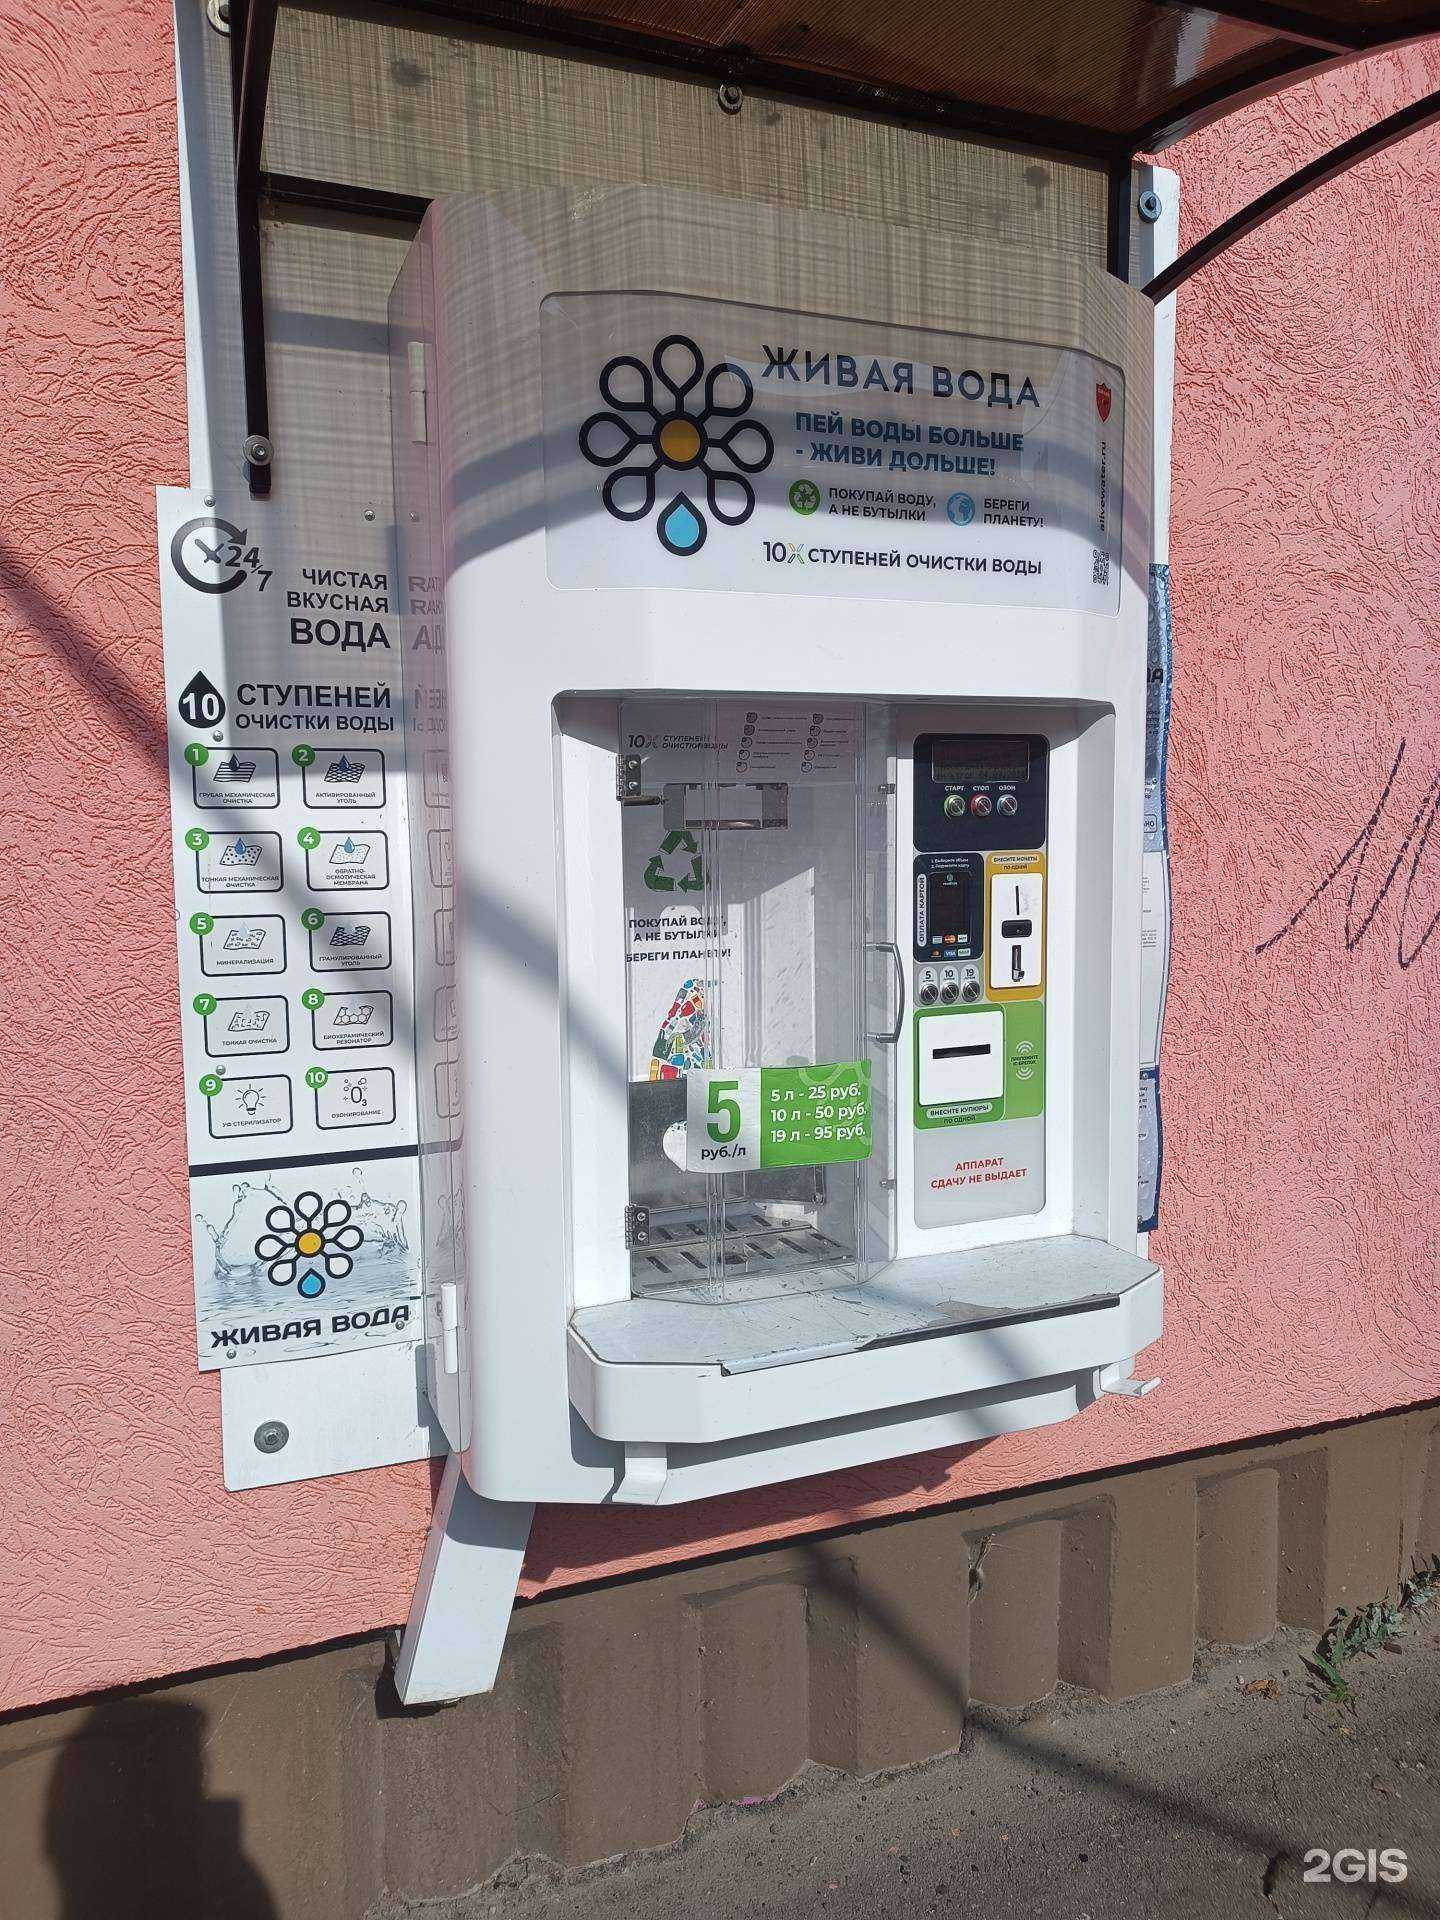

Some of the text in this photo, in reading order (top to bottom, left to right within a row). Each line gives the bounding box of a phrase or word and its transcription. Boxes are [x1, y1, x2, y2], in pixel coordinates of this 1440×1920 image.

[761, 344, 1041, 409] ЖИВАЯ ВОДА
[795, 411, 1024, 451] ПЕЙ ВОДЫ БОЛЬШЕ
[810, 442, 882, 466] ЖИВИ
[889, 450, 996, 476] ДОЛЬШЕ!
[1097, 441, 1107, 532] alivewater.ru
[829, 487, 936, 508] ПОКУПАЙ ВОДУ,
[984, 498, 1030, 511] БЕРЕГИ
[829, 504, 926, 521] А НЕ БУТЫЛКИ
[983, 513, 1044, 528] ПЛАНЕТУ!
[808, 548, 901, 568] СТУПЕНЕЙ
[906, 554, 987, 572] ОЧИСТКИ
[992, 558, 1042, 576] ВОДЫ
[302, 568, 387, 590] ЧИСТАЯ
[287, 591, 389, 613] ВКУСНАЯ
[290, 618, 391, 652] ВОДА
[236, 682, 391, 708] СТУПЕНЕЙ
[182, 693, 220, 720] 10
[235, 714, 330, 730] ОЧИСТКИ
[336, 715, 394, 733] ВОДЫ
[192, 748, 199, 761] 1
[298, 749, 309, 761] 2
[192, 833, 203, 846] 3
[303, 832, 315, 845] 4
[196, 918, 208, 930] 5
[308, 913, 318, 925] 6
[628, 916, 687, 929] ПОКУПАЙ
[633, 932, 642, 942] А
[645, 931, 661, 941] НЕ
[216, 958, 274, 966] МИНЕРАЛИЗАЦИЯ
[319, 954, 382, 962] ГРАНУЛИРОВАННЫЙ
[626, 952, 670, 963] БЕРЕГИ
[925, 971, 931, 979] 5
[945, 970, 953, 978] 10
[966, 968, 974, 976] 19
[199, 999, 210, 1011] 7
[308, 993, 319, 1005] 8
[323, 1031, 385, 1040] БИОКЕРАМИЧЕСКИЙ
[336, 1037, 372, 1045] РЕЗОНАТОР
[308, 1072, 325, 1083] 10
[205, 1079, 217, 1092] 9
[771, 1089, 780, 1102] 5
[784, 1091, 794, 1101] л
[808, 1085, 826, 1099] 25
[830, 1083, 862, 1100] руб.
[331, 1109, 381, 1119] ОЗОНИРОВАНИЕ
[707, 1081, 741, 1143] 5
[771, 1109, 787, 1123] 10
[790, 1111, 801, 1122] л
[815, 1106, 833, 1119] 50
[838, 1102, 867, 1120] руб.
[930, 1105, 989, 1116] ВНЕСИТЕ КУПЮРЫ
[233, 1118, 282, 1127] СТЕРИЛИЗАТОР
[771, 1130, 786, 1143] 19
[789, 1132, 800, 1142] л
[814, 1127, 833, 1140] 95
[837, 1123, 866, 1141] руб.
[701, 1143, 746, 1160] руб./л
[955, 1157, 1004, 1171] АППАРАТ
[931, 1168, 1028, 1189] СДАЧУ НЕ ВЫДАЕТ
[210, 1304, 410, 1349] ЖИВАЯ ВОДА
